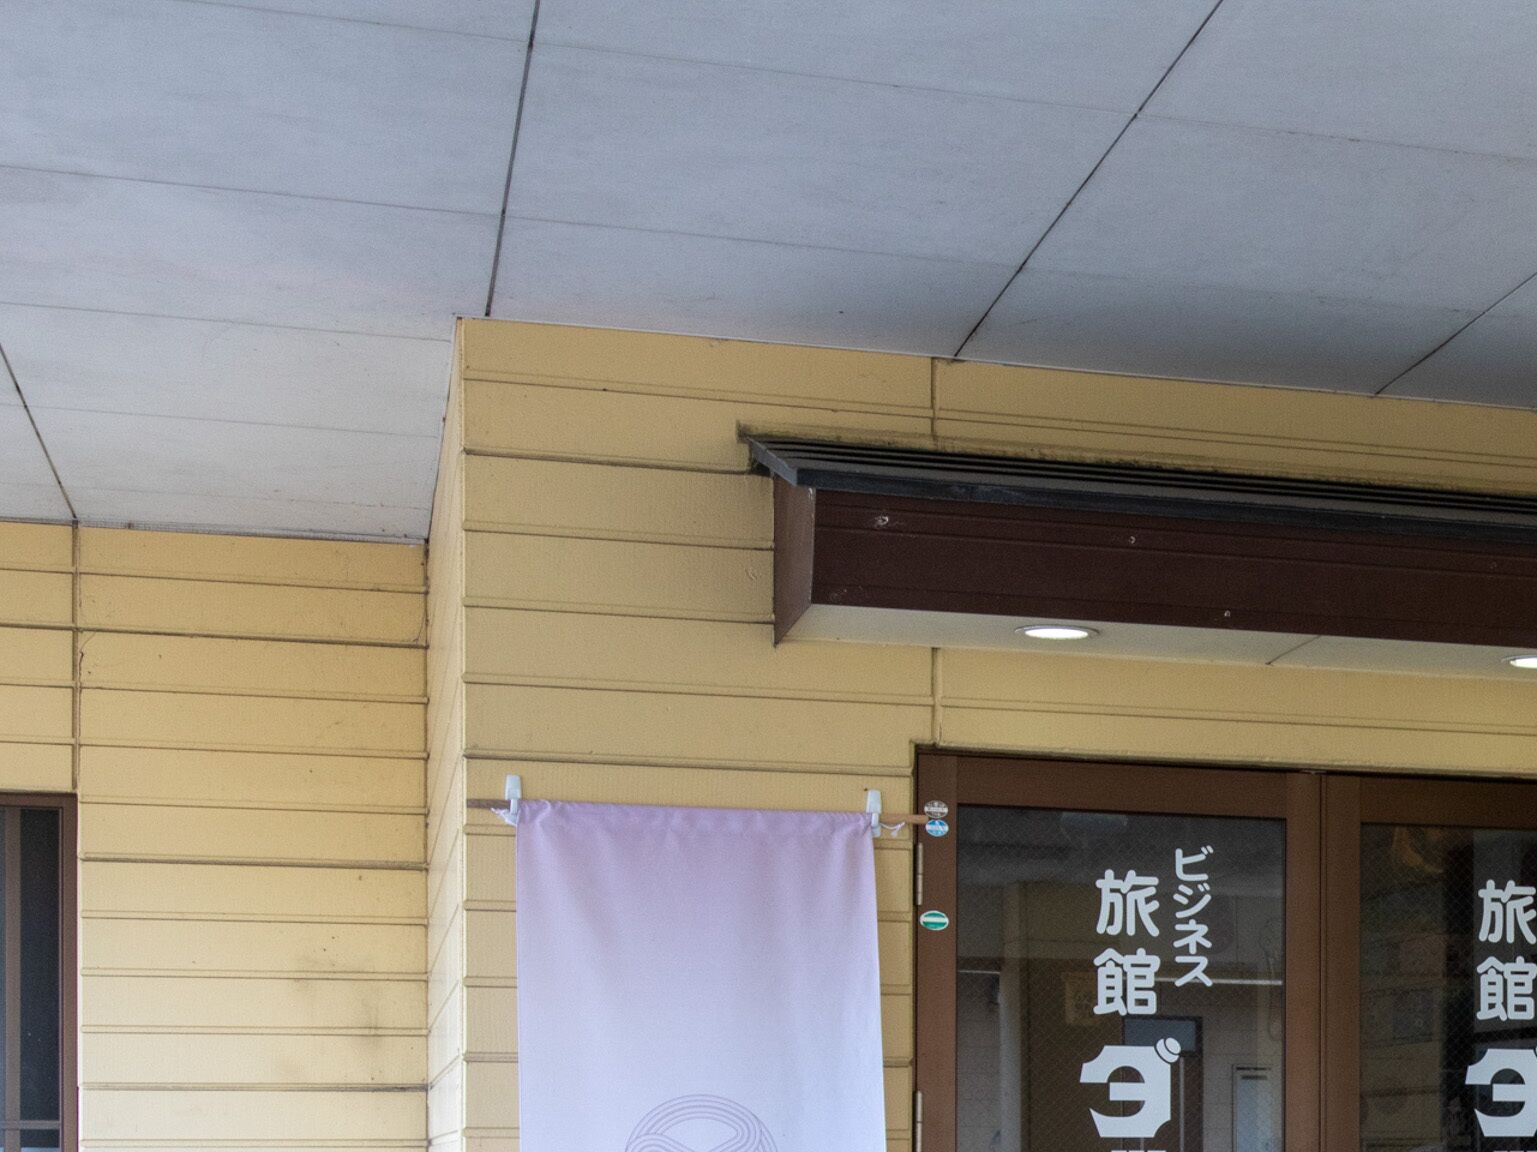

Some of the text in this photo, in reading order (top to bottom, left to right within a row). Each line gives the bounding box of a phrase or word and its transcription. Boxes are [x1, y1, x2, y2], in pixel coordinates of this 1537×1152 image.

[1093, 868, 1161, 1016] 旅館
[1173, 845, 1214, 987] ビジネス
